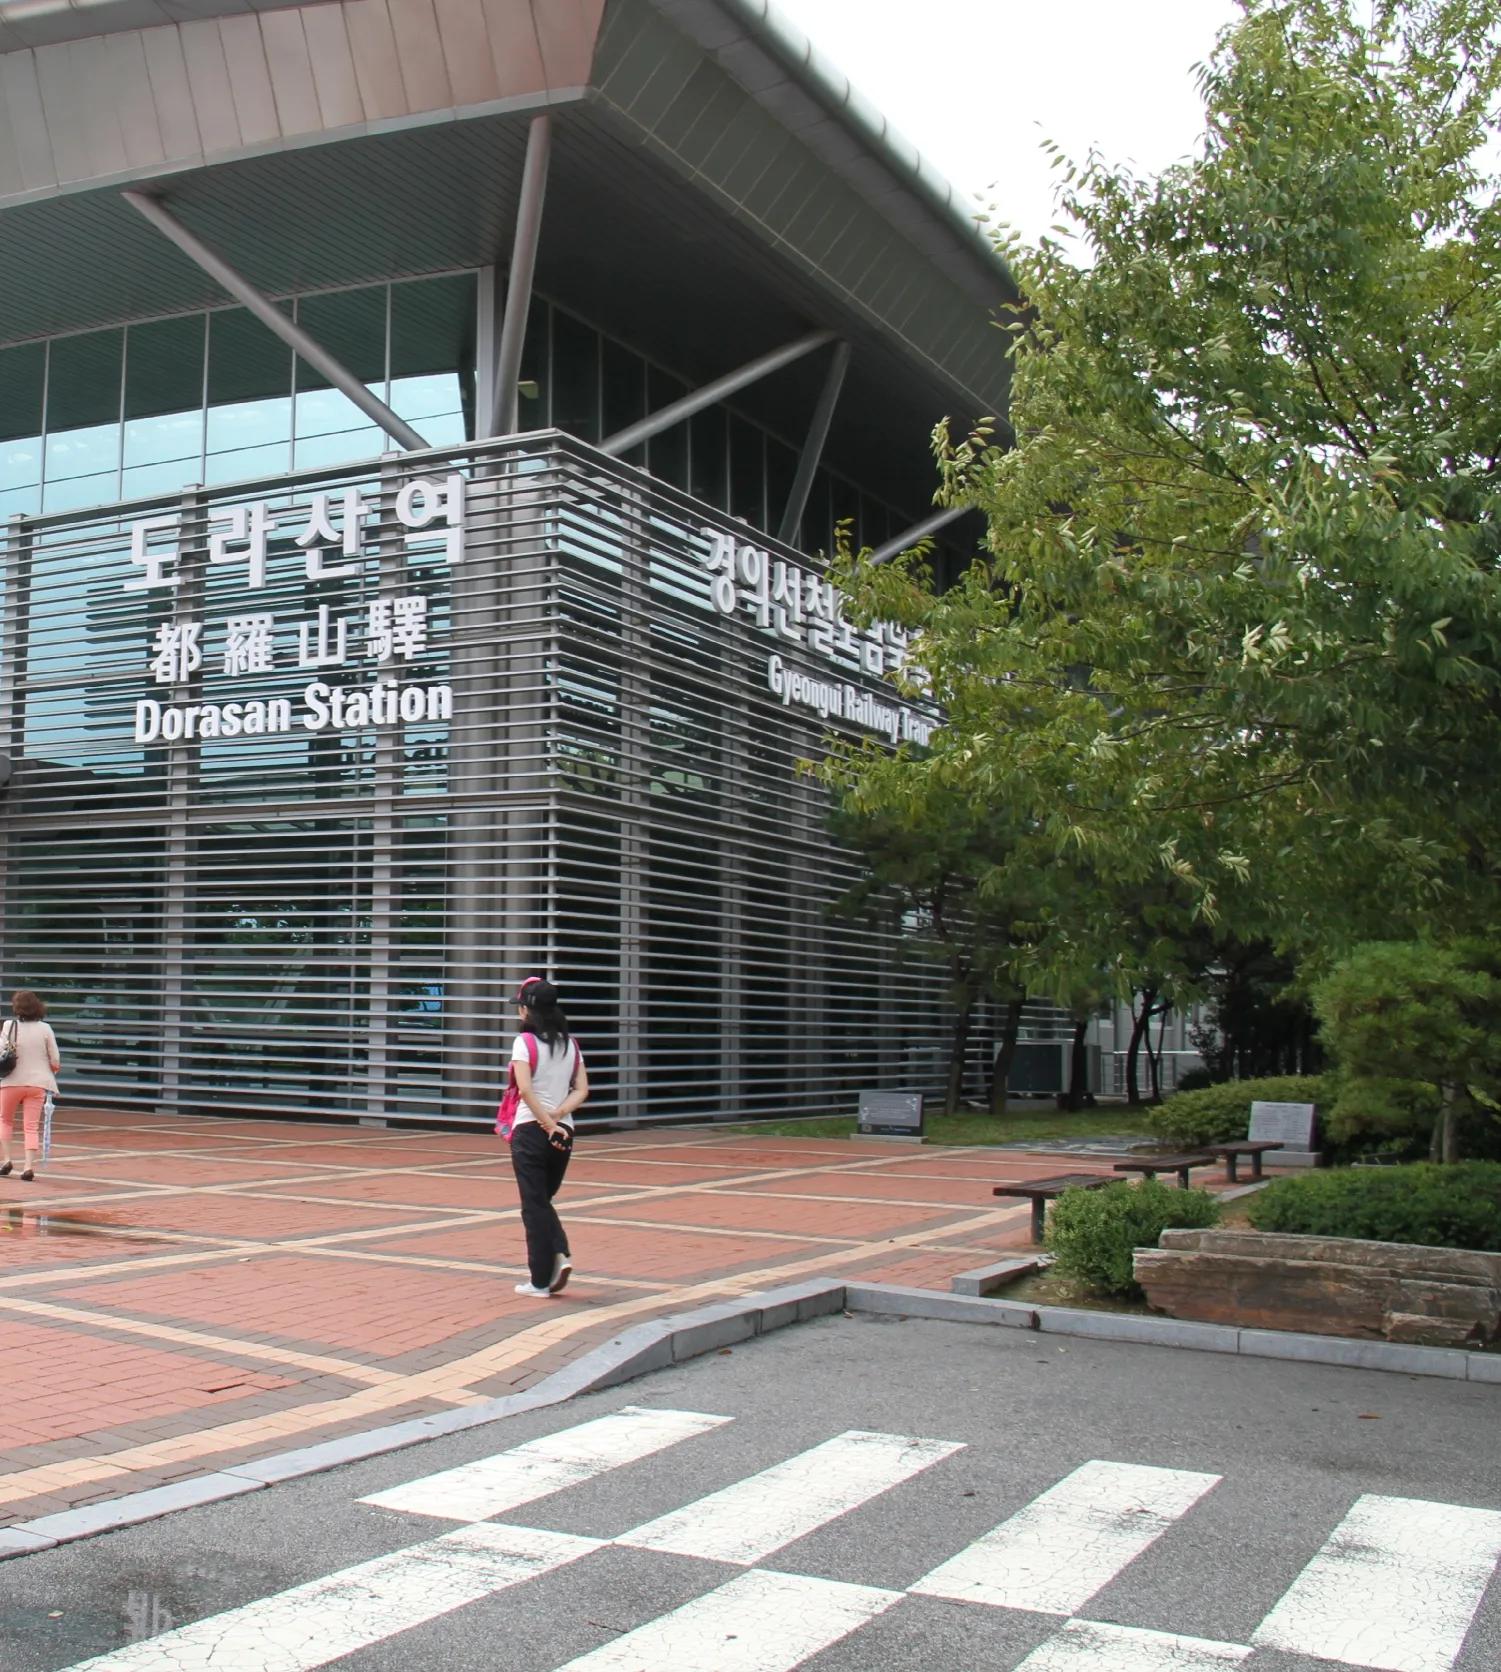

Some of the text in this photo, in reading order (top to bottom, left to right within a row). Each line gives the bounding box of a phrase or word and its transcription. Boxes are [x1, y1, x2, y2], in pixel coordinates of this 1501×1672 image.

[123, 474, 466, 591] 도라산역
[150, 595, 428, 683] 都羅山驛
[135, 680, 453, 743] Dorasan Station
[768, 654, 843, 718] Gyeongui
[843, 684, 899, 744] Railway
